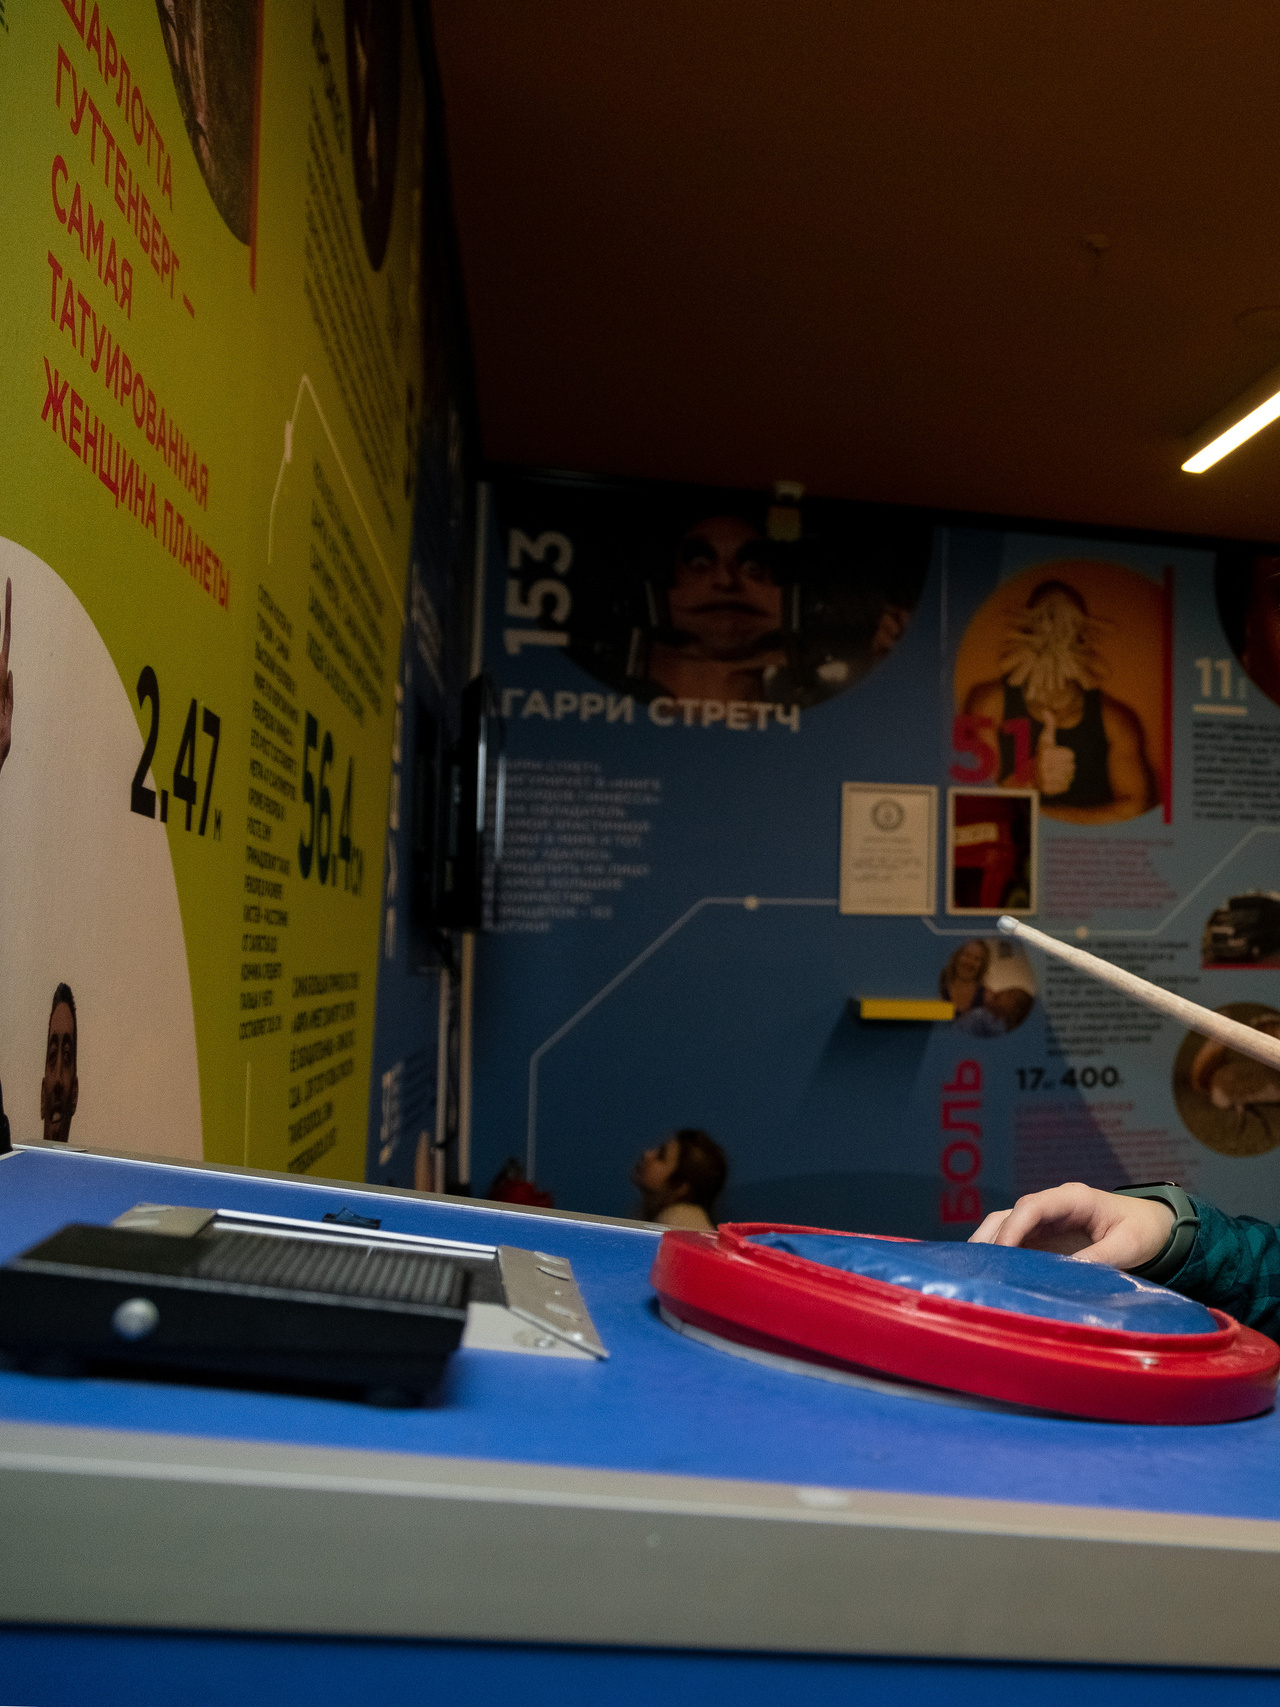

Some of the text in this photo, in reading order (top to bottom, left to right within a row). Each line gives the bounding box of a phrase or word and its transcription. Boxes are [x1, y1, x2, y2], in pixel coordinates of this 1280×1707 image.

[51, 154, 133, 321] САМАЯ
[55, 44, 180, 299] ГУТТЕНБЕРГ
[47, 250, 210, 512] ТАТУИРОВАННАЯ
[41, 356, 231, 611] ЖЕНЩИНА ПЛАНЕТЫ
[504, 528, 574, 655] 153
[501, 688, 801, 733] ГАРРИ СТРЕТЧ
[950, 713, 1034, 786] 51
[940, 1058, 983, 1224] БОЛЬ
